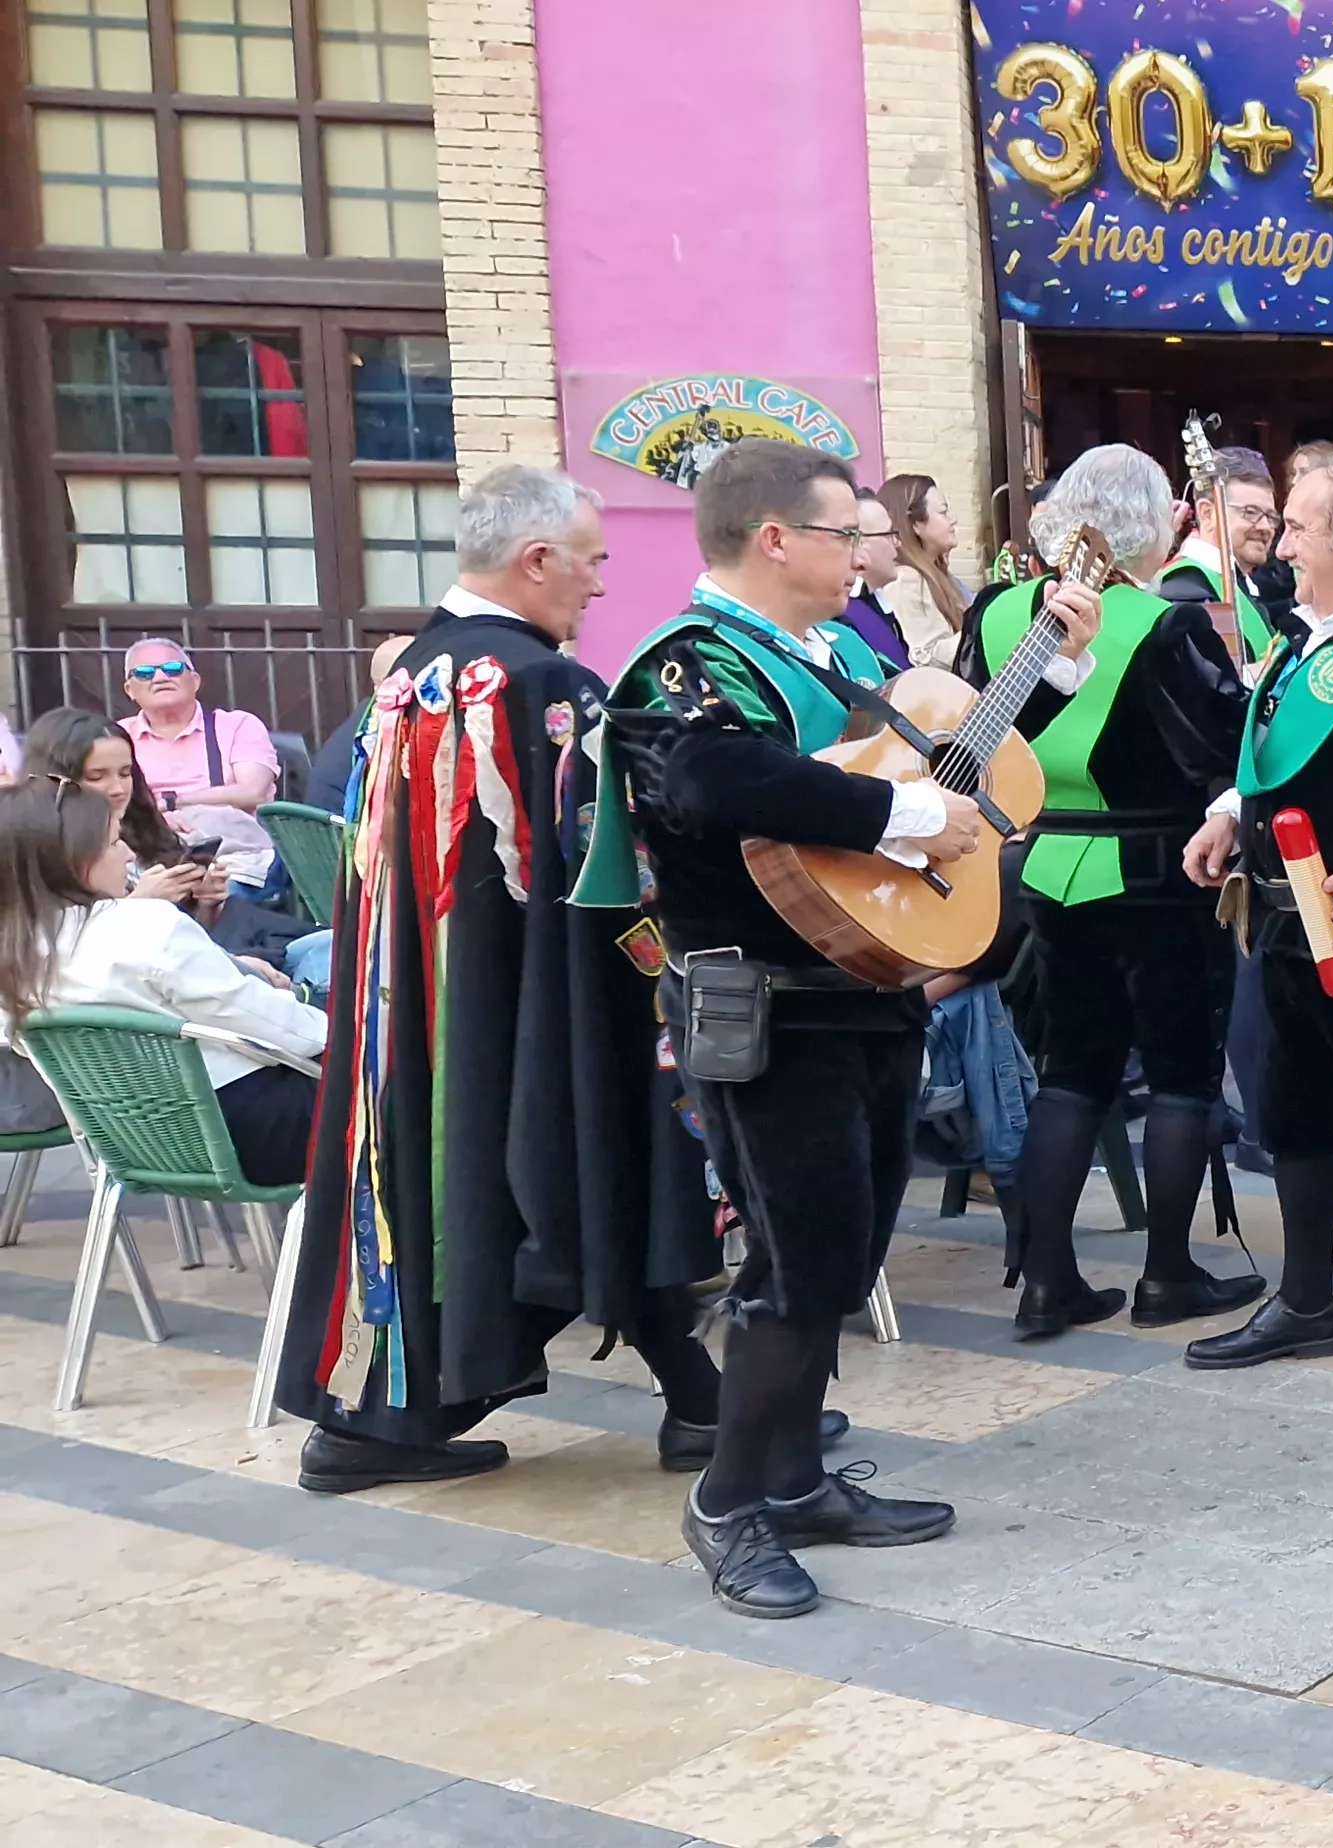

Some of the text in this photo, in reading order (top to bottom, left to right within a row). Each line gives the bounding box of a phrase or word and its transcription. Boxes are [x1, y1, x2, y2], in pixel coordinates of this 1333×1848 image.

[1048, 201, 1333, 286] Años contigo
[610, 378, 752, 447] CENTRAL
